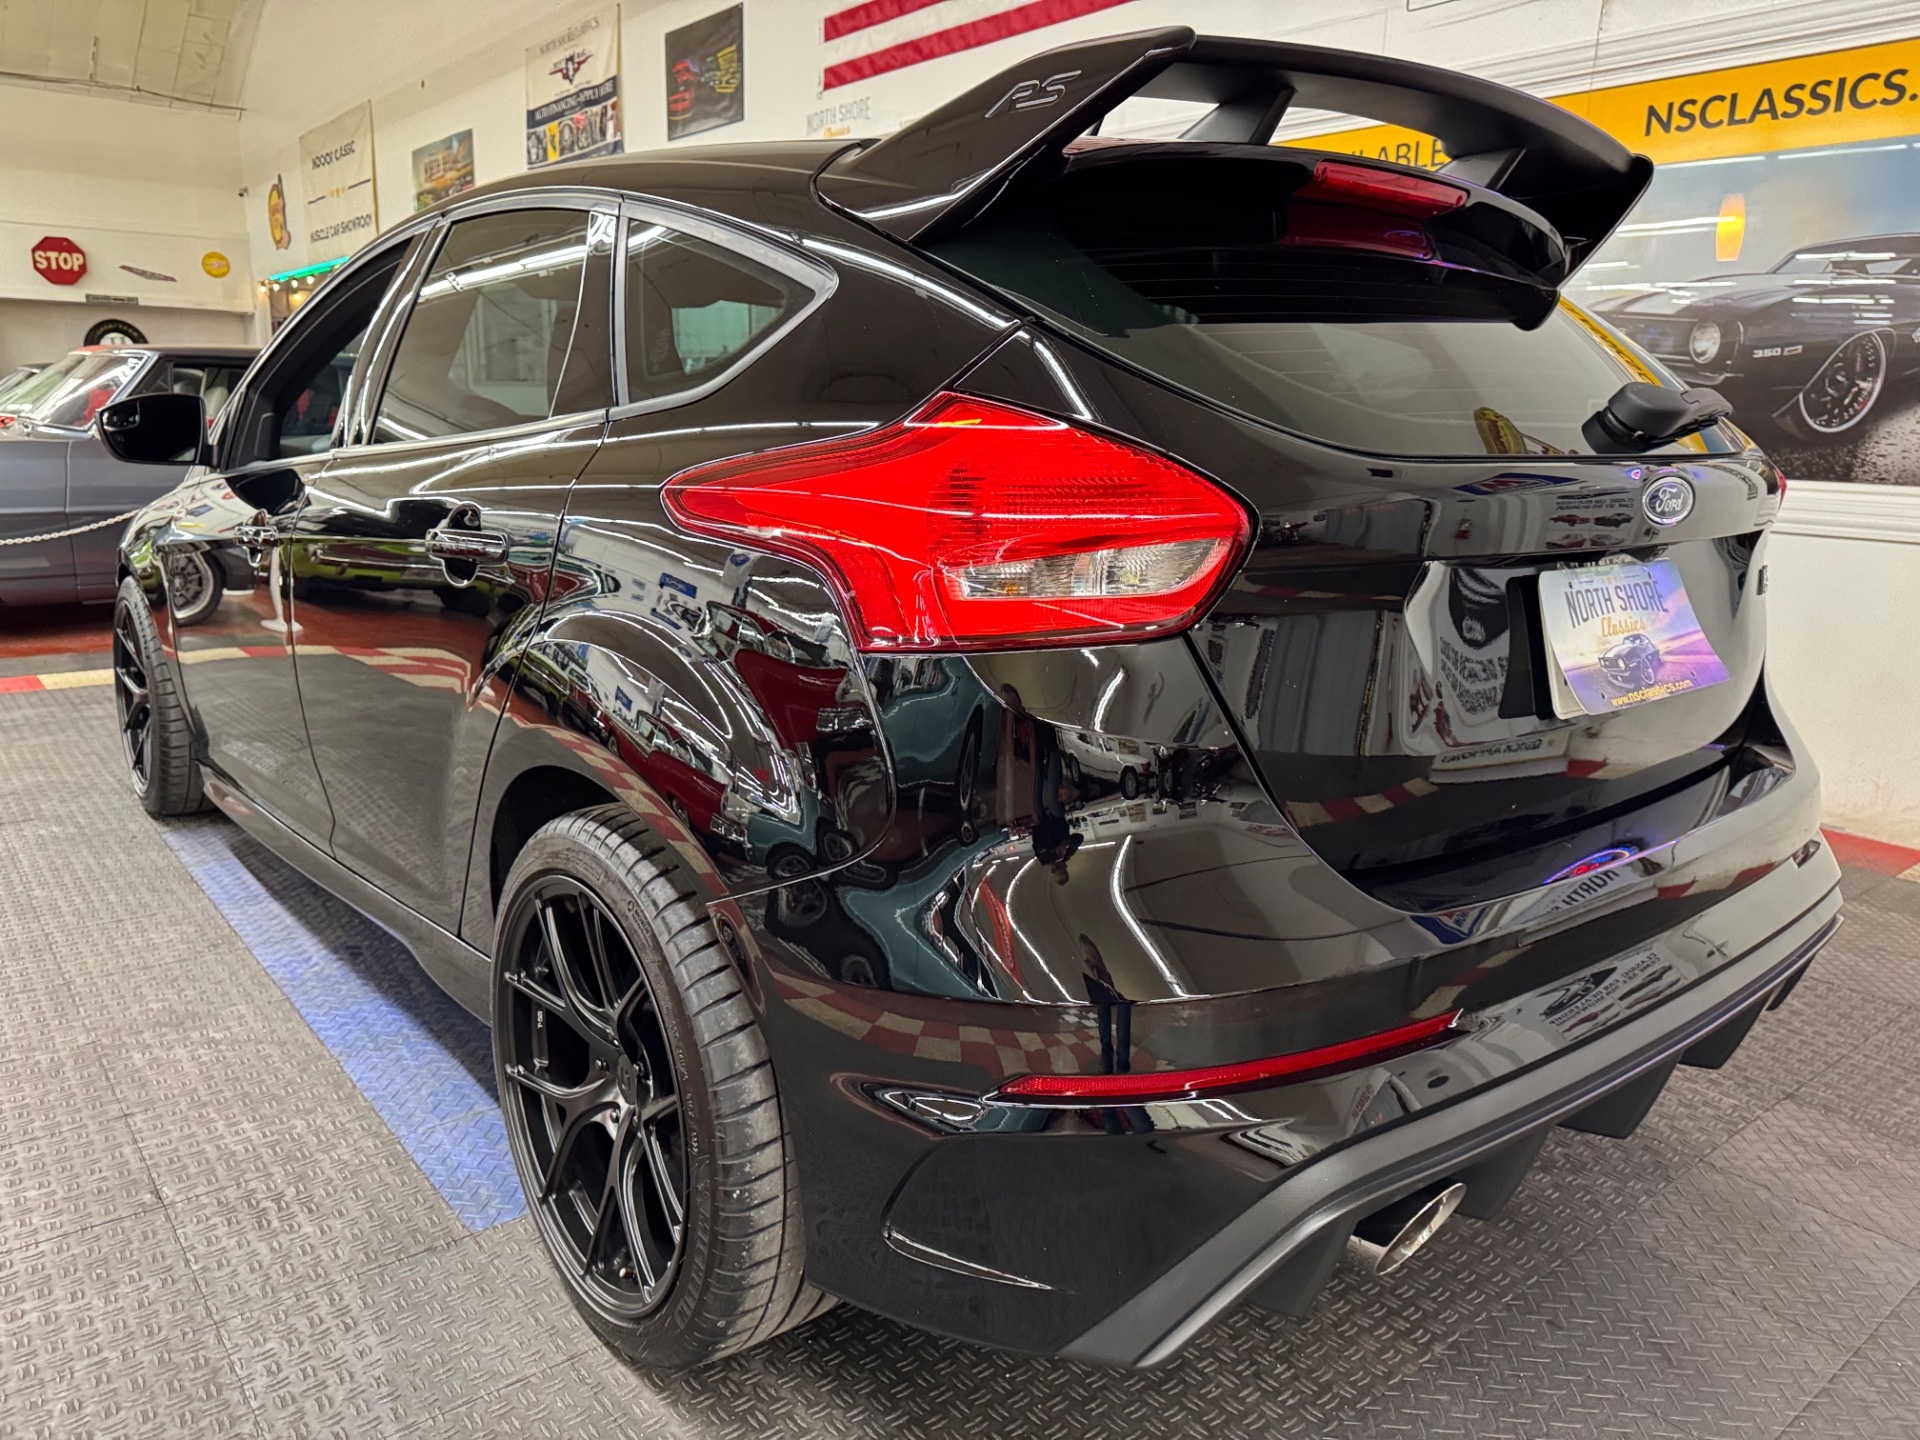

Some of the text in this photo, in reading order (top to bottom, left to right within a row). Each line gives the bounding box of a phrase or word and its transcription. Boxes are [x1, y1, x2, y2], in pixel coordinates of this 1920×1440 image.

[984, 69, 1082, 118] RS
[806, 96, 871, 137] NORTH SHORE
[34, 250, 84, 272] STOP
[1752, 347, 1782, 359] 350
[1655, 486, 1684, 513] Ford
[1564, 580, 1670, 629] NORTH SHORE
[1600, 615, 1647, 638] Classics
[1610, 679, 1694, 707] www.nsclassics.com
